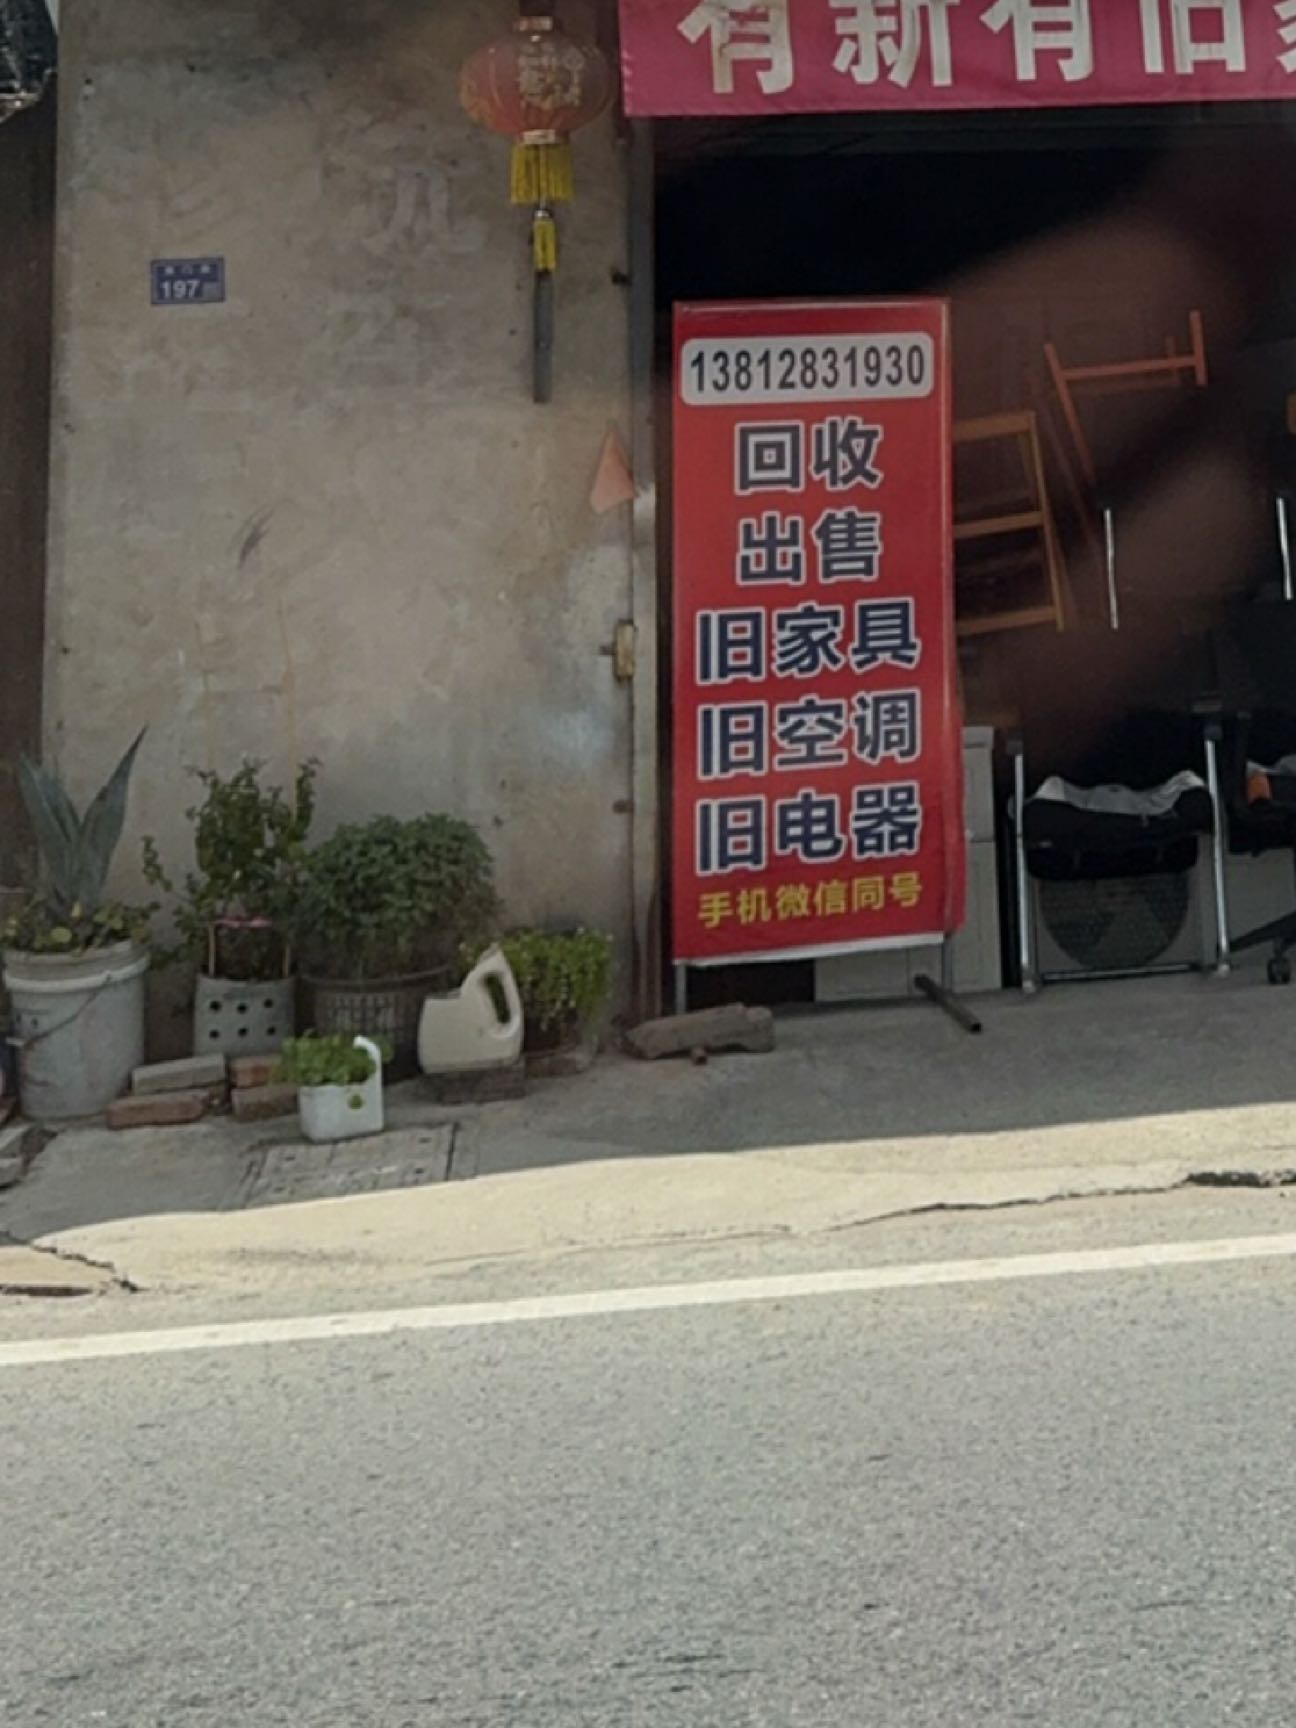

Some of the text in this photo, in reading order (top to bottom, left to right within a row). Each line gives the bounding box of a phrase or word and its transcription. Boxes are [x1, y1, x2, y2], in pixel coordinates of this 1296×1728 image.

[690, 344, 925, 393] 13812831930
[733, 415, 883, 494] 回收
[735, 506, 882, 586] 出售
[696, 597, 921, 684] 旧家具
[697, 689, 921, 780] 旧空调
[696, 783, 921, 876] 旧电器
[698, 871, 922, 928] 手机微信同号
